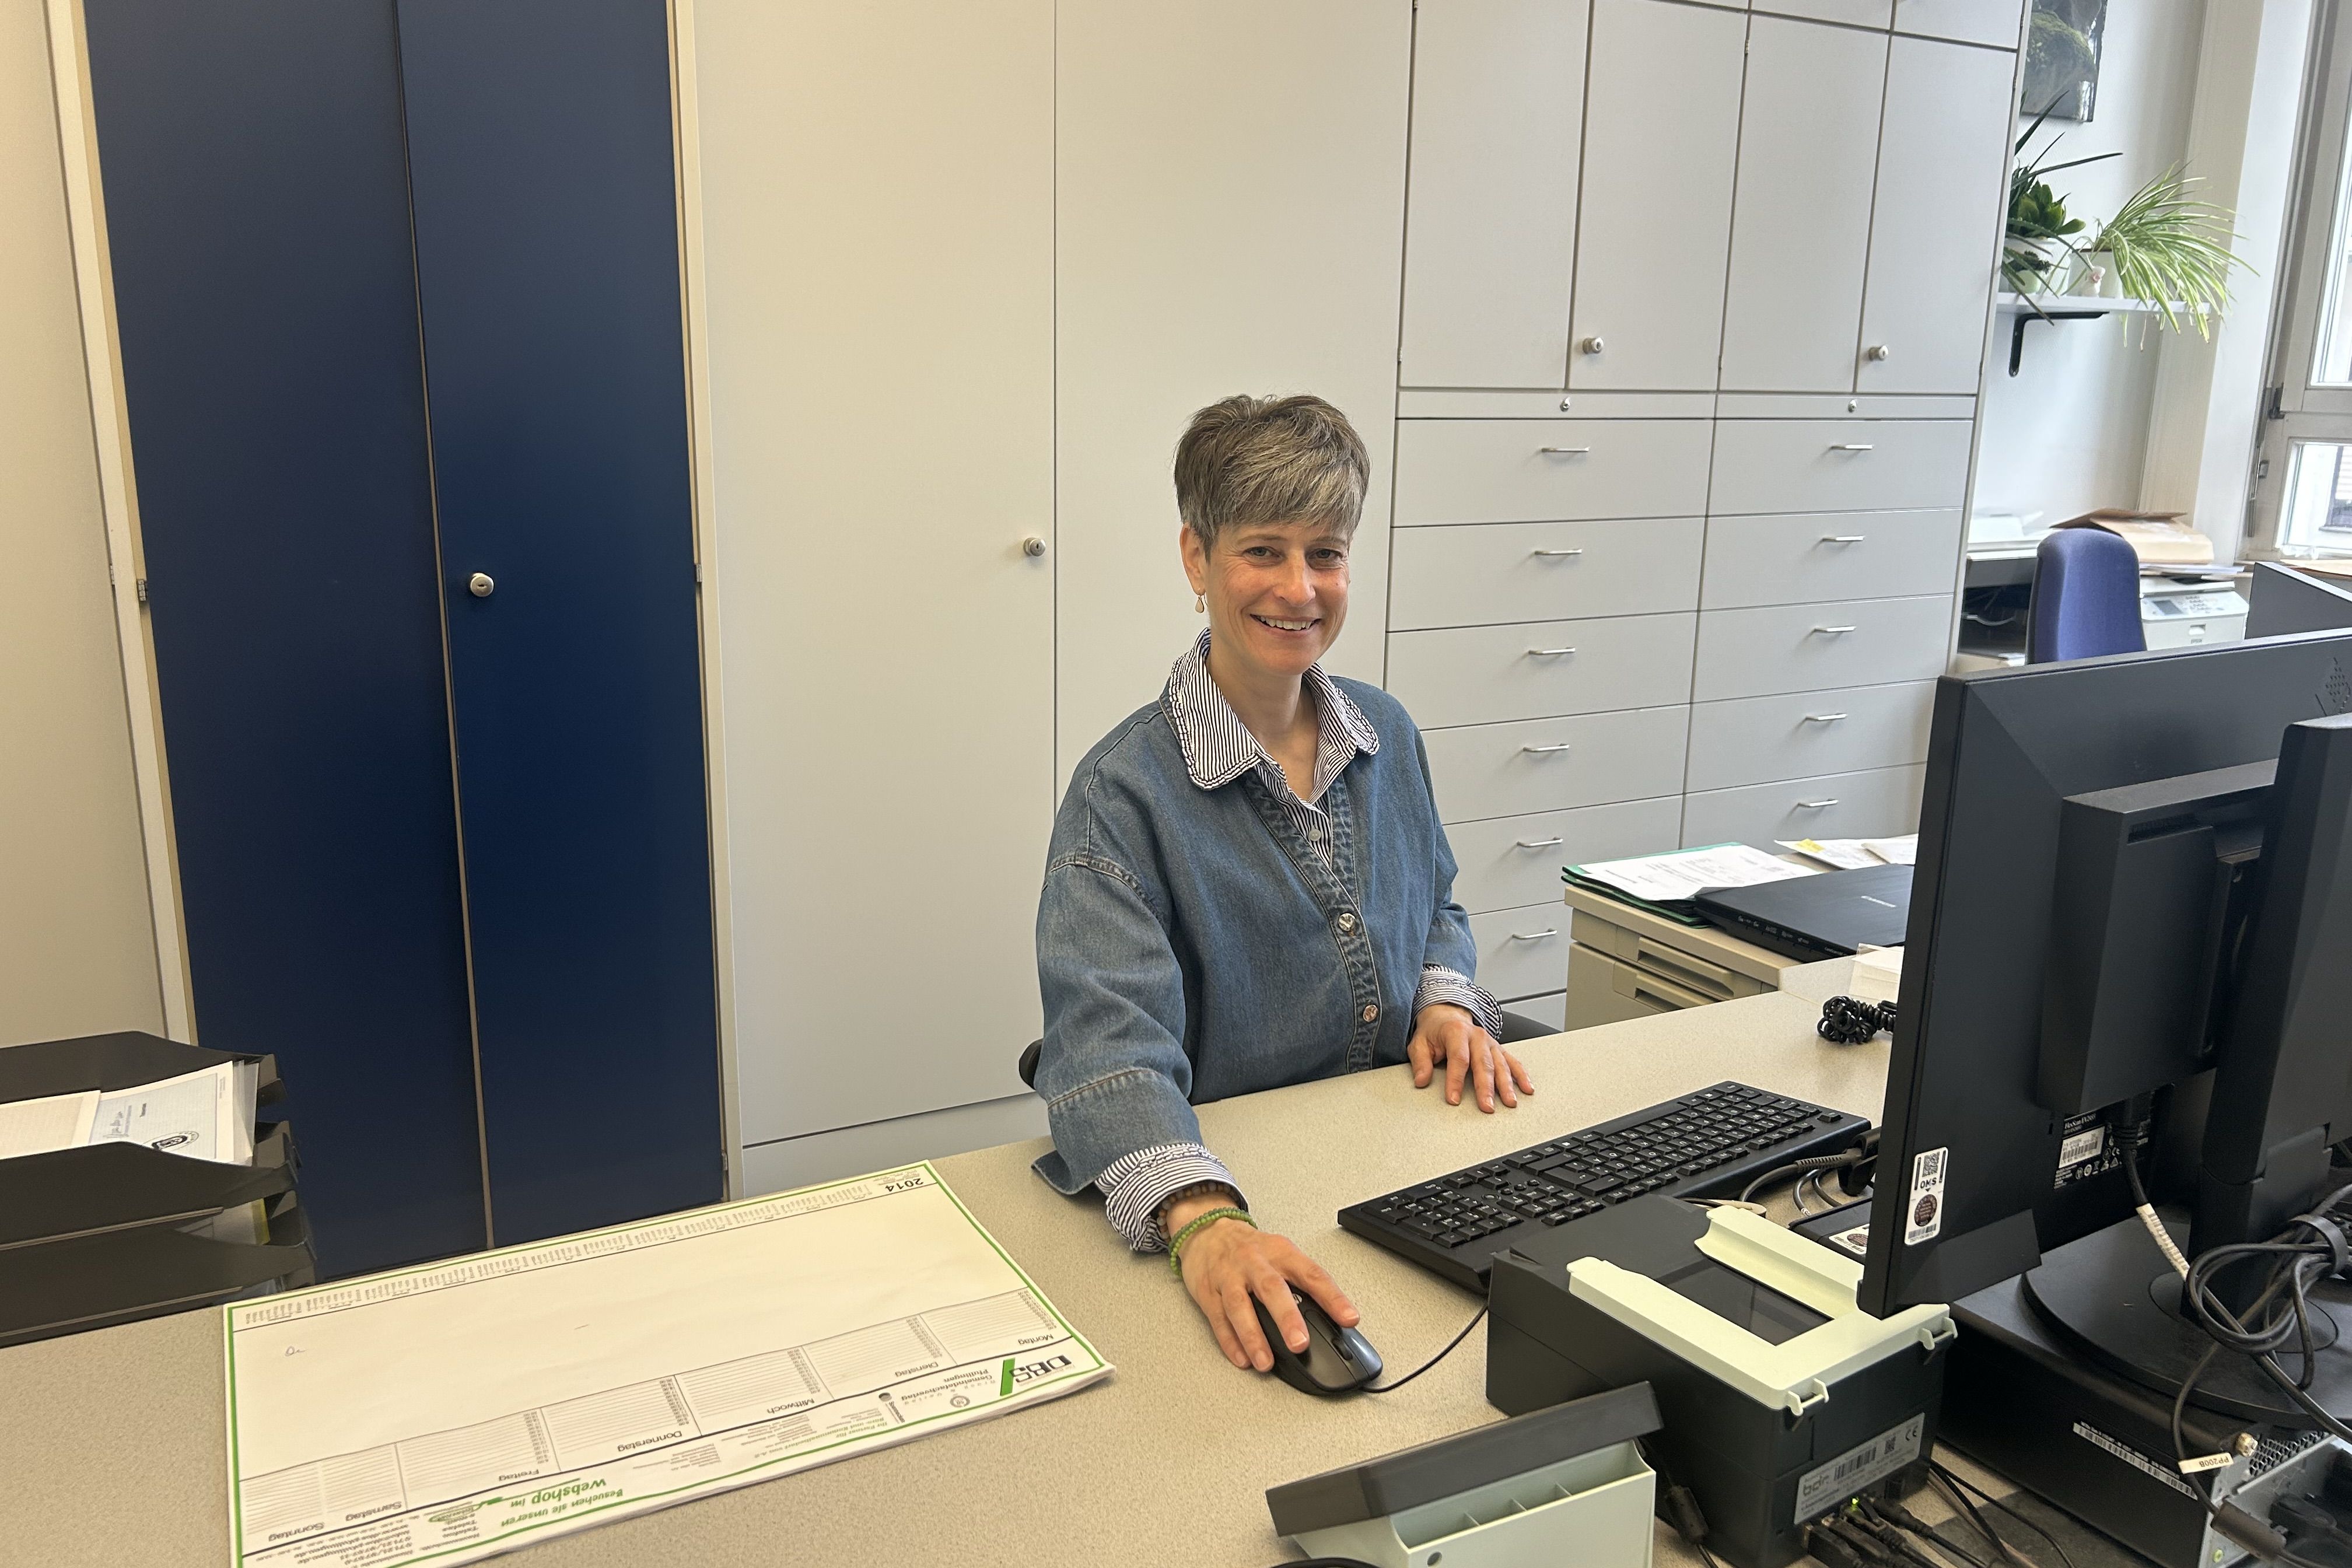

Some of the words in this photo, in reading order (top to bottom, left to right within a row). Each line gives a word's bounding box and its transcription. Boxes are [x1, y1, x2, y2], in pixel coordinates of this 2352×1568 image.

[883, 1177, 925, 1192] 2014
[1920, 1177, 1937, 1189] OMS
[1016, 1333, 1055, 1346] Montag
[893, 1361, 940, 1377] Dienstag
[765, 1397, 816, 1415] Mittwoch
[615, 1430, 683, 1452] Donnerstag
[497, 1468, 540, 1482] Freitag
[528, 1478, 607, 1508] webshop
[570, 1488, 624, 1508] Besuchen
[344, 1500, 402, 1522] Samstag
[509, 1497, 527, 1509] im
[499, 1508, 549, 1527] unseren
[267, 1521, 325, 1542] Sonntag
